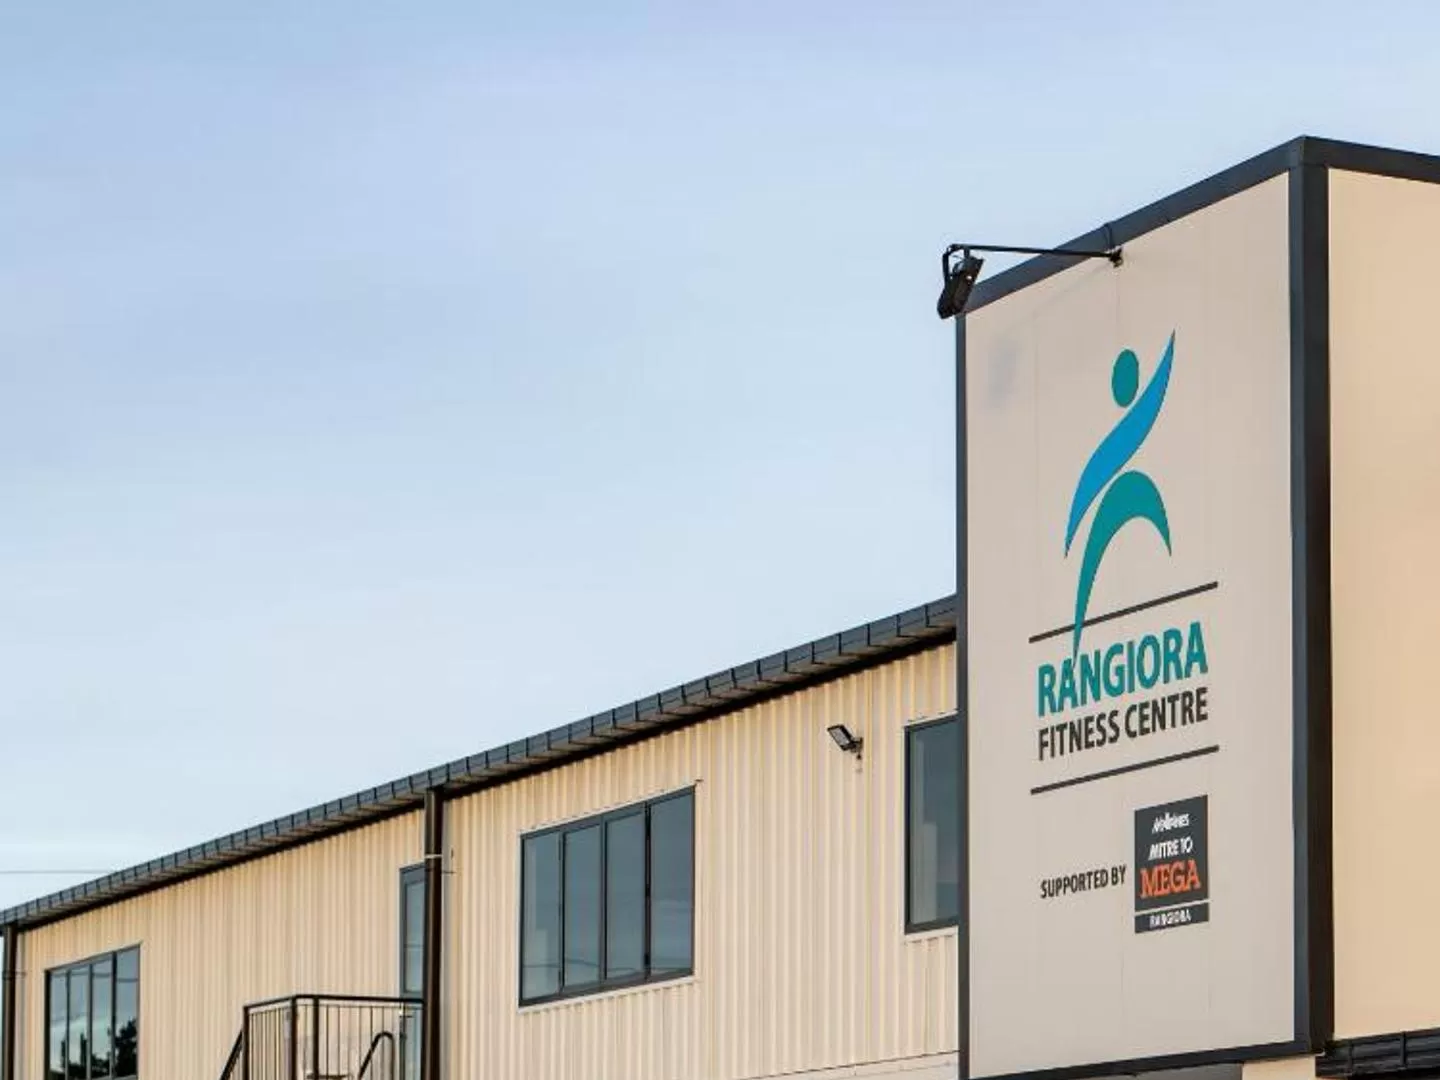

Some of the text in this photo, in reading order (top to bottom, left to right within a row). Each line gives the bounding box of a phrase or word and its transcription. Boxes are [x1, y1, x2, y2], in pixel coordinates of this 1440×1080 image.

[1038, 621, 1208, 717] RANGIORA
[1038, 686, 1208, 761] FITNESS CENTRE
[1148, 835, 1193, 861] MITRE 10
[1040, 864, 1127, 899] SUPPORTED BY
[1139, 859, 1201, 900] MEGA
